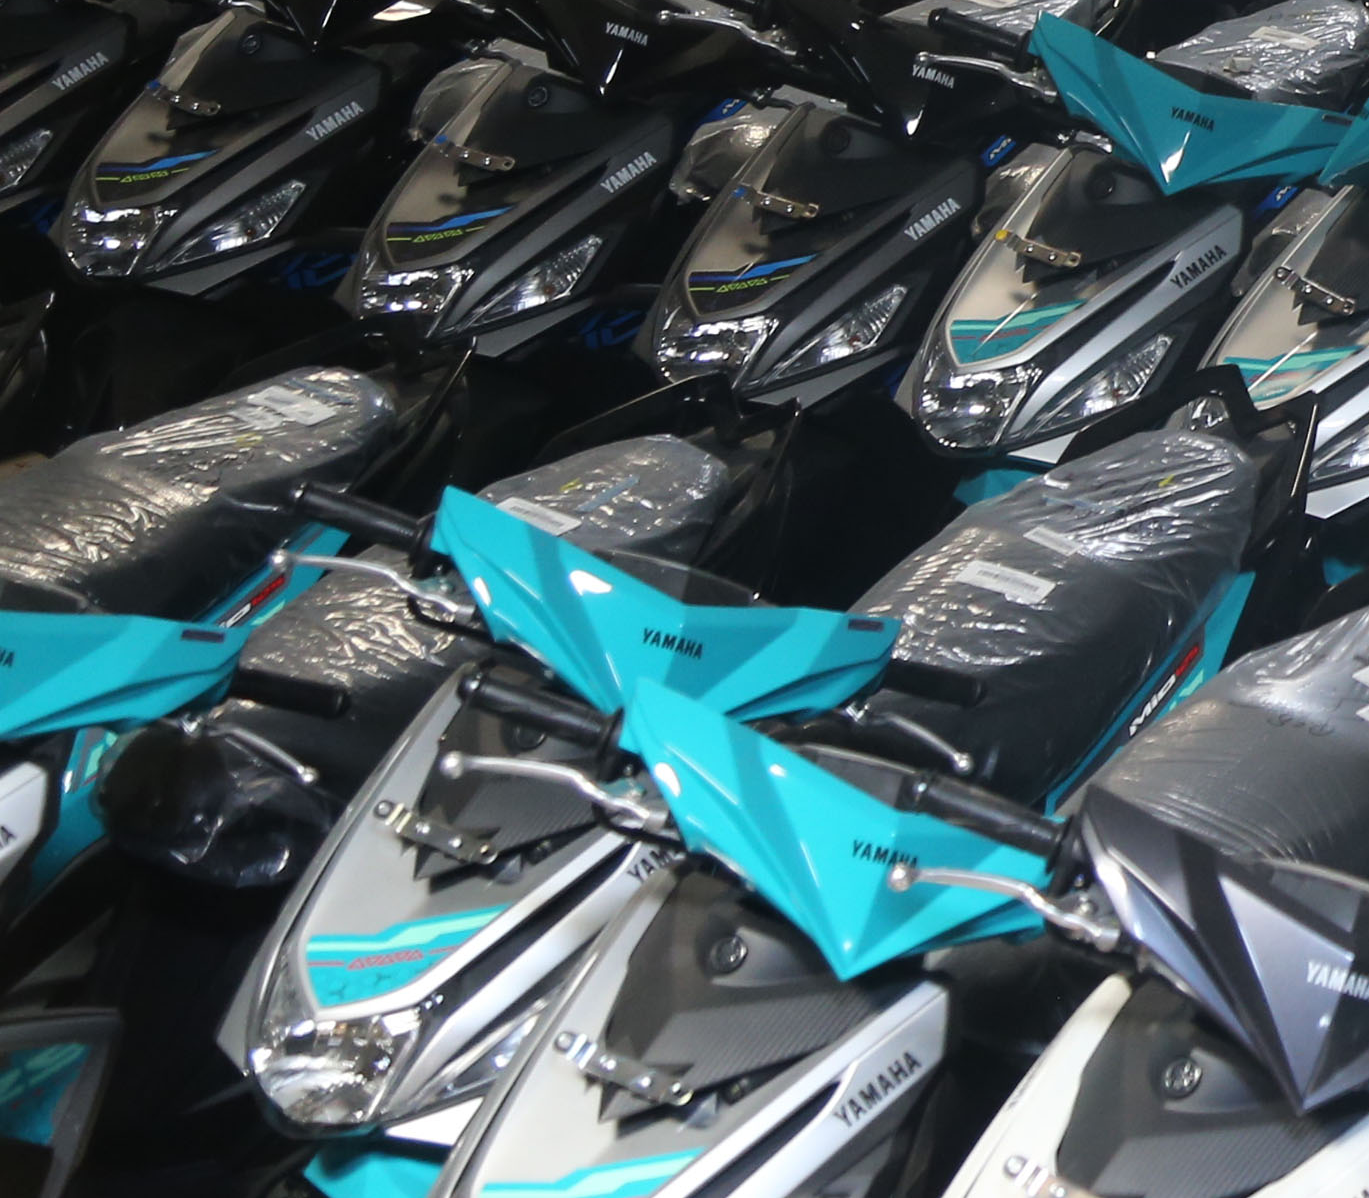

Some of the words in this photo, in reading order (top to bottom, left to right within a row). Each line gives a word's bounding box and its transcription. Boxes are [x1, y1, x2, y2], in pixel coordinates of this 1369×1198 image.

[606, 21, 649, 46] YAMAHA
[51, 51, 109, 91] YAMAHA
[912, 64, 955, 89] YAMAHA
[305, 101, 365, 141] YAMAHA
[1170, 106, 1215, 132] YAMAHA
[600, 151, 657, 194] YAMAHA
[904, 197, 961, 241] YAMAHA
[1169, 244, 1228, 289] YAMAHA
[642, 628, 704, 660] YAMAHA
[853, 839, 918, 871] YAMAHA
[833, 1050, 923, 1130] YAMAHA
